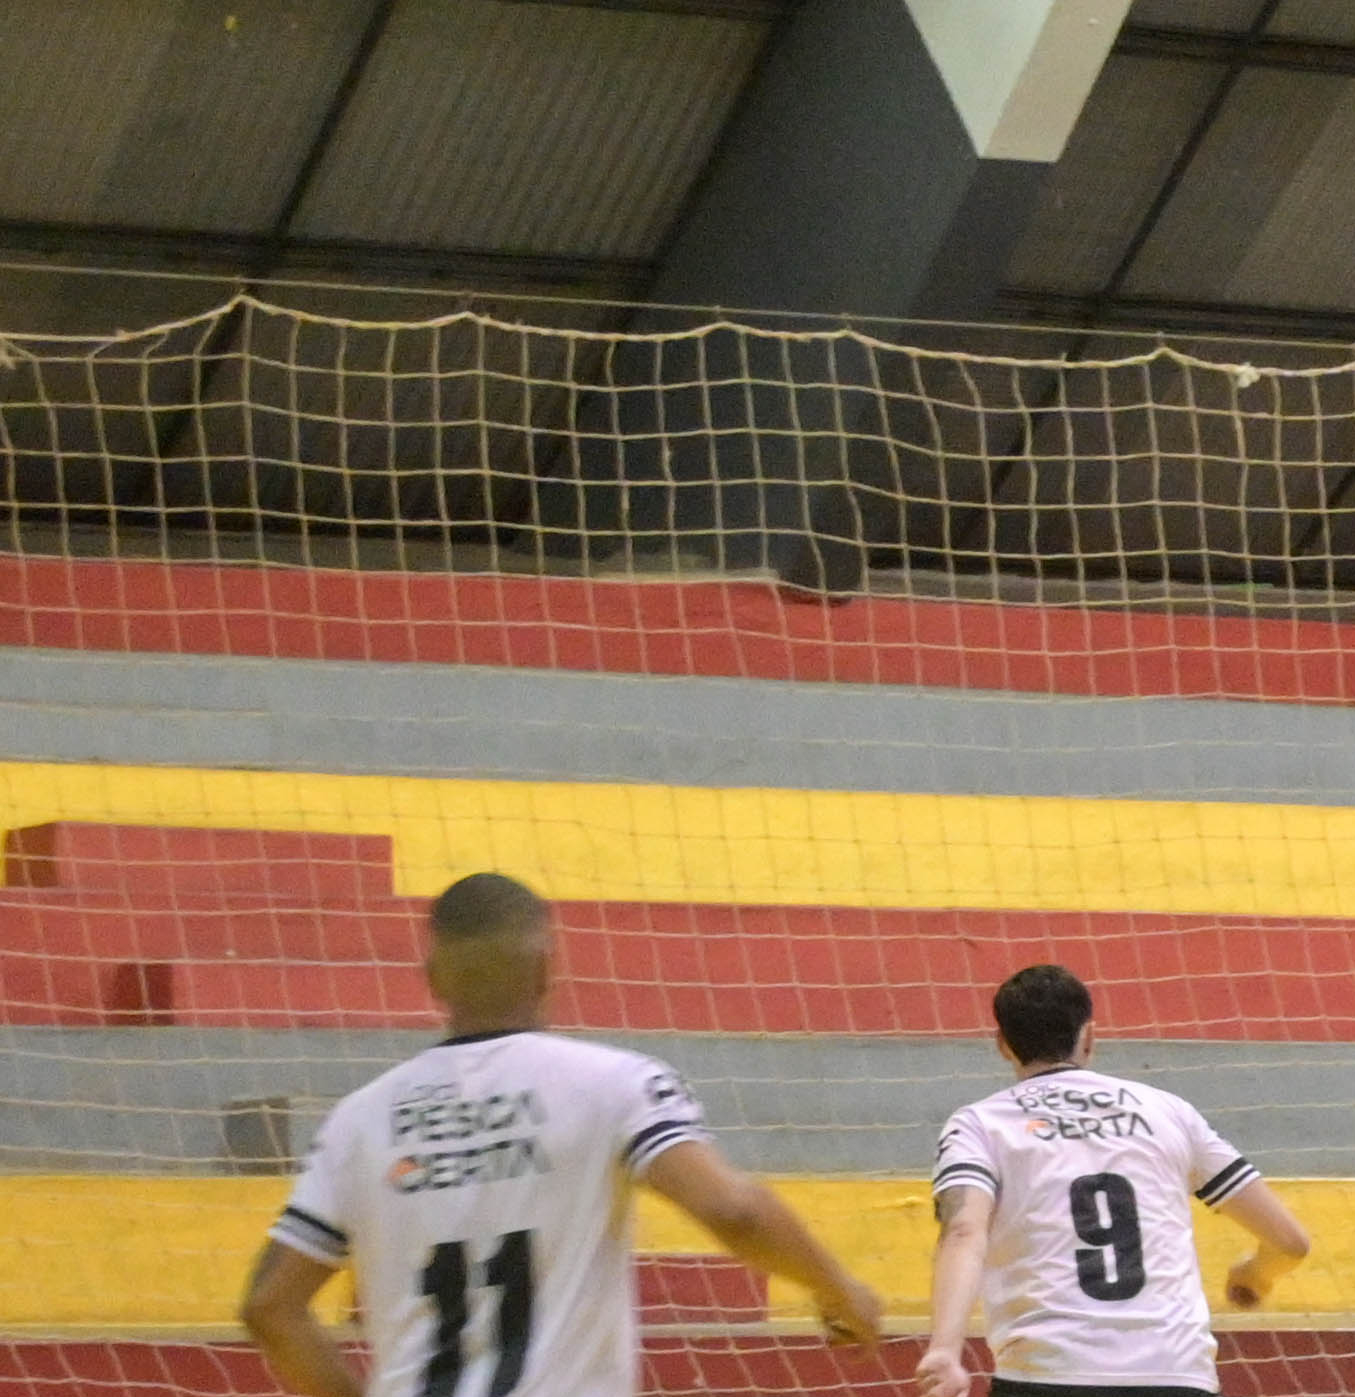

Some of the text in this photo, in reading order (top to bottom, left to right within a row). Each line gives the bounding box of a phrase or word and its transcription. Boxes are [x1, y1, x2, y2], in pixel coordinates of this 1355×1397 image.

[1015, 1087, 1142, 1114] PESCA
[1026, 1111, 1154, 1141] CERTA
[1069, 1172, 1146, 1301] 9
